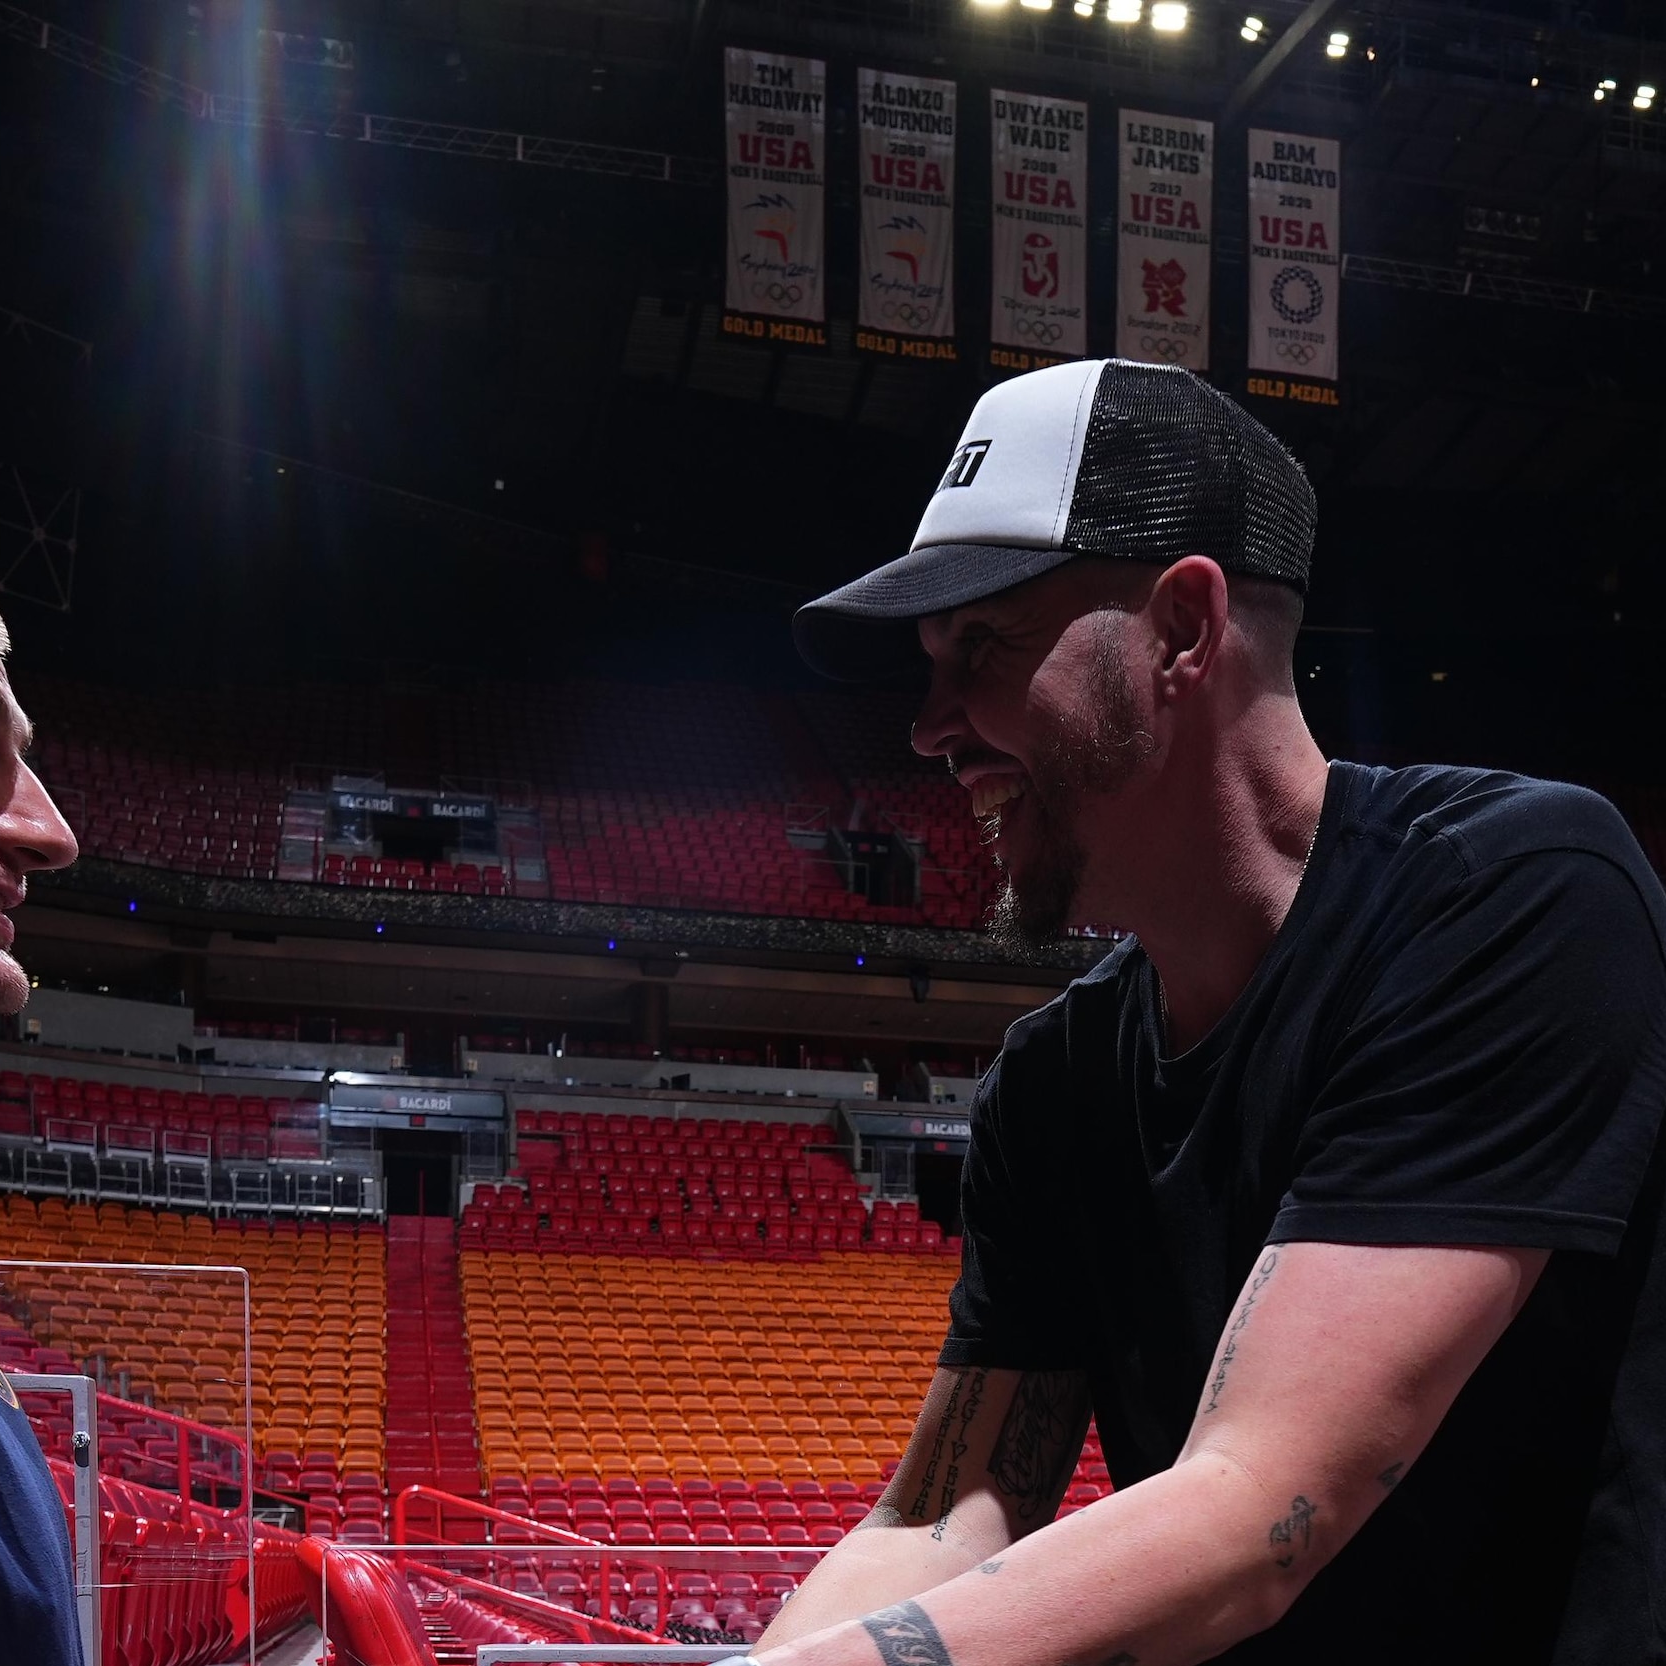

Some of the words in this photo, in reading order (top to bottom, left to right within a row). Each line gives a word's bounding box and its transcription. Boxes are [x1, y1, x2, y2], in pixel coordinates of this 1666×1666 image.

[757, 64, 794, 88] TIM
[729, 83, 823, 114] HARDAWAY
[872, 82, 944, 111] ALONZO
[861, 104, 953, 136] MOURNING
[995, 100, 1084, 132] DWYANE
[739, 134, 814, 170] USA
[1010, 125, 1070, 152] WADE
[1127, 123, 1205, 152] LEBRON
[1133, 148, 1200, 174] JAMES
[1273, 141, 1316, 165] BAM
[871, 154, 945, 192] USA
[1253, 161, 1336, 189] ADEBAYO
[1005, 171, 1076, 209] USA
[1149, 182, 1182, 196] 2012
[1131, 193, 1201, 230] USA
[1260, 215, 1328, 251] USA
[723, 316, 765, 338] GOLD
[769, 322, 826, 346] MEDAL
[856, 332, 896, 355] GOLD
[901, 340, 957, 360] MEDAL
[990, 349, 1030, 370] GOLD
[1247, 378, 1285, 399] GOLD
[1289, 383, 1339, 406] MEDAL
